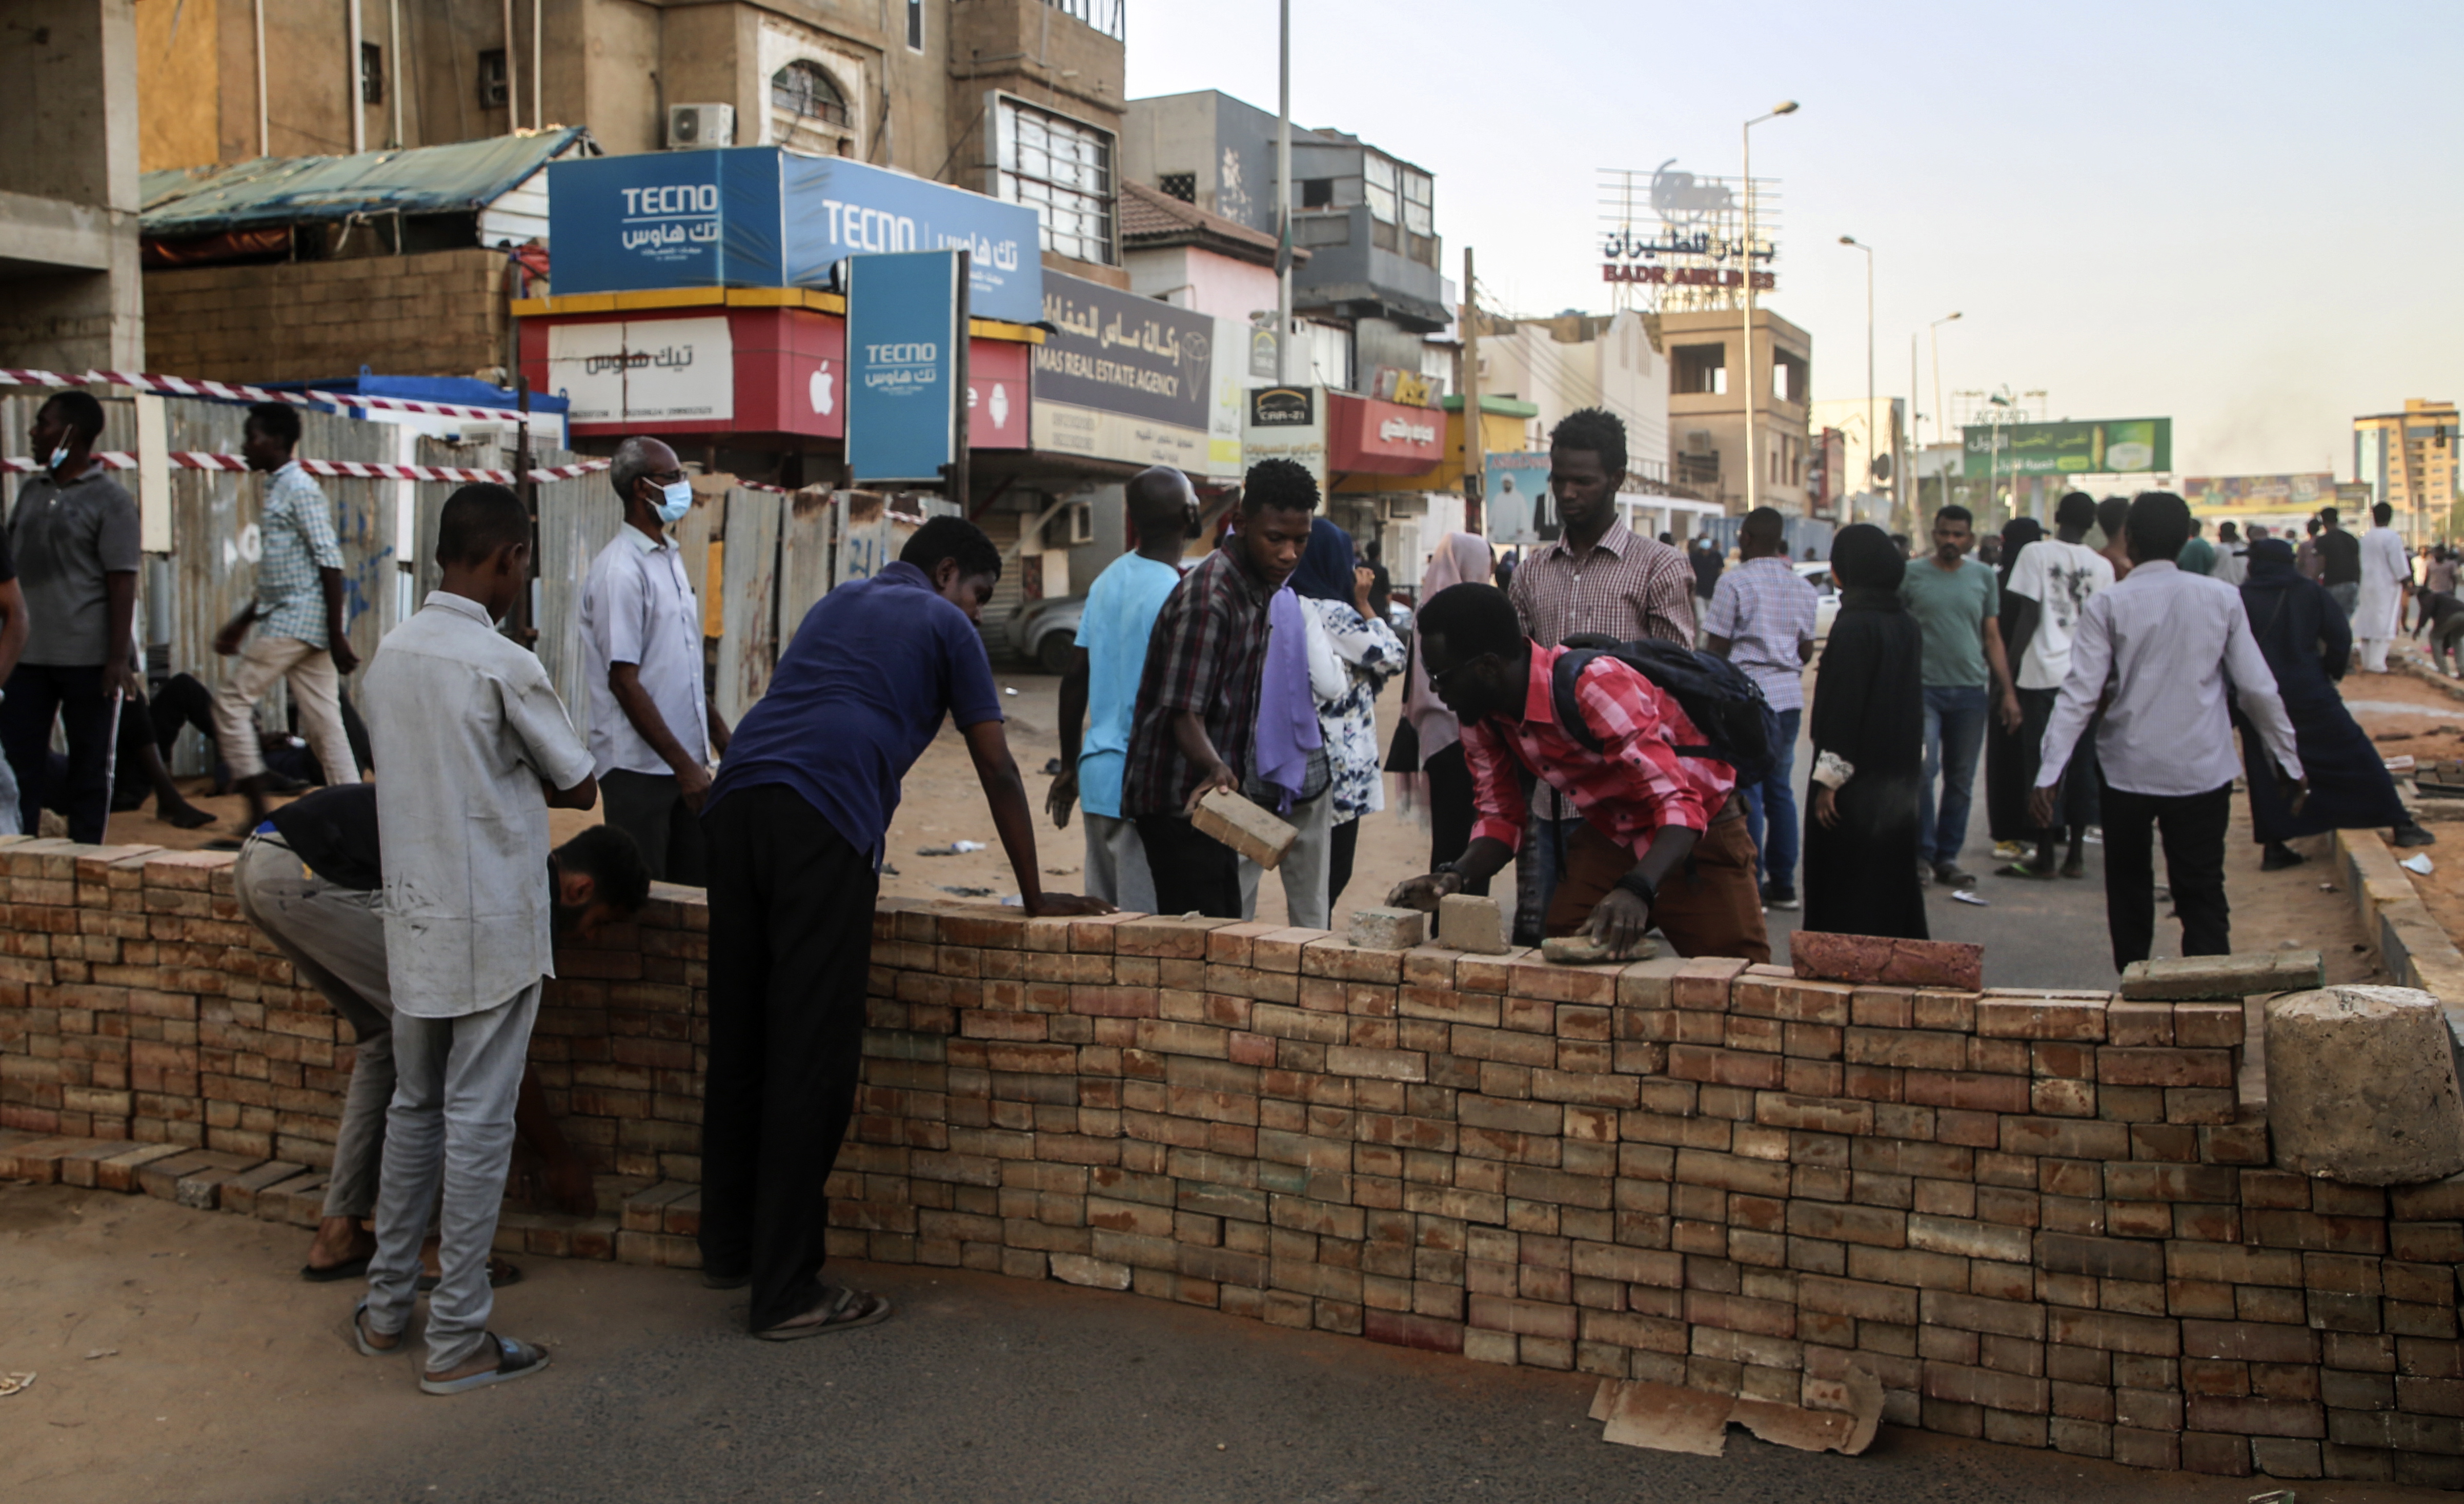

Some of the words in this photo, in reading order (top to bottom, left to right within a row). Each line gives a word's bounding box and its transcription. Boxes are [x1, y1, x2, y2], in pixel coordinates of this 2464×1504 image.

[621, 184, 718, 215] TECNO
[622, 223, 686, 250] هاوس
[689, 222, 720, 242] تك
[822, 198, 916, 252] TECNO
[993, 239, 1019, 272] تك
[1603, 264, 1665, 284] BADR
[1673, 267, 1775, 289] AIRLINES
[1100, 311, 1140, 350] ماس
[1141, 319, 1180, 367] وكالة
[654, 345, 693, 372] تيك
[865, 342, 937, 363] TECNO
[864, 370, 912, 388] هاوس
[913, 368, 937, 383] تك
[1036, 345, 1064, 373] MAS
[1064, 350, 1095, 380] REAL
[1095, 358, 1136, 388] ESTATE
[1135, 367, 1180, 398] AGENCY
